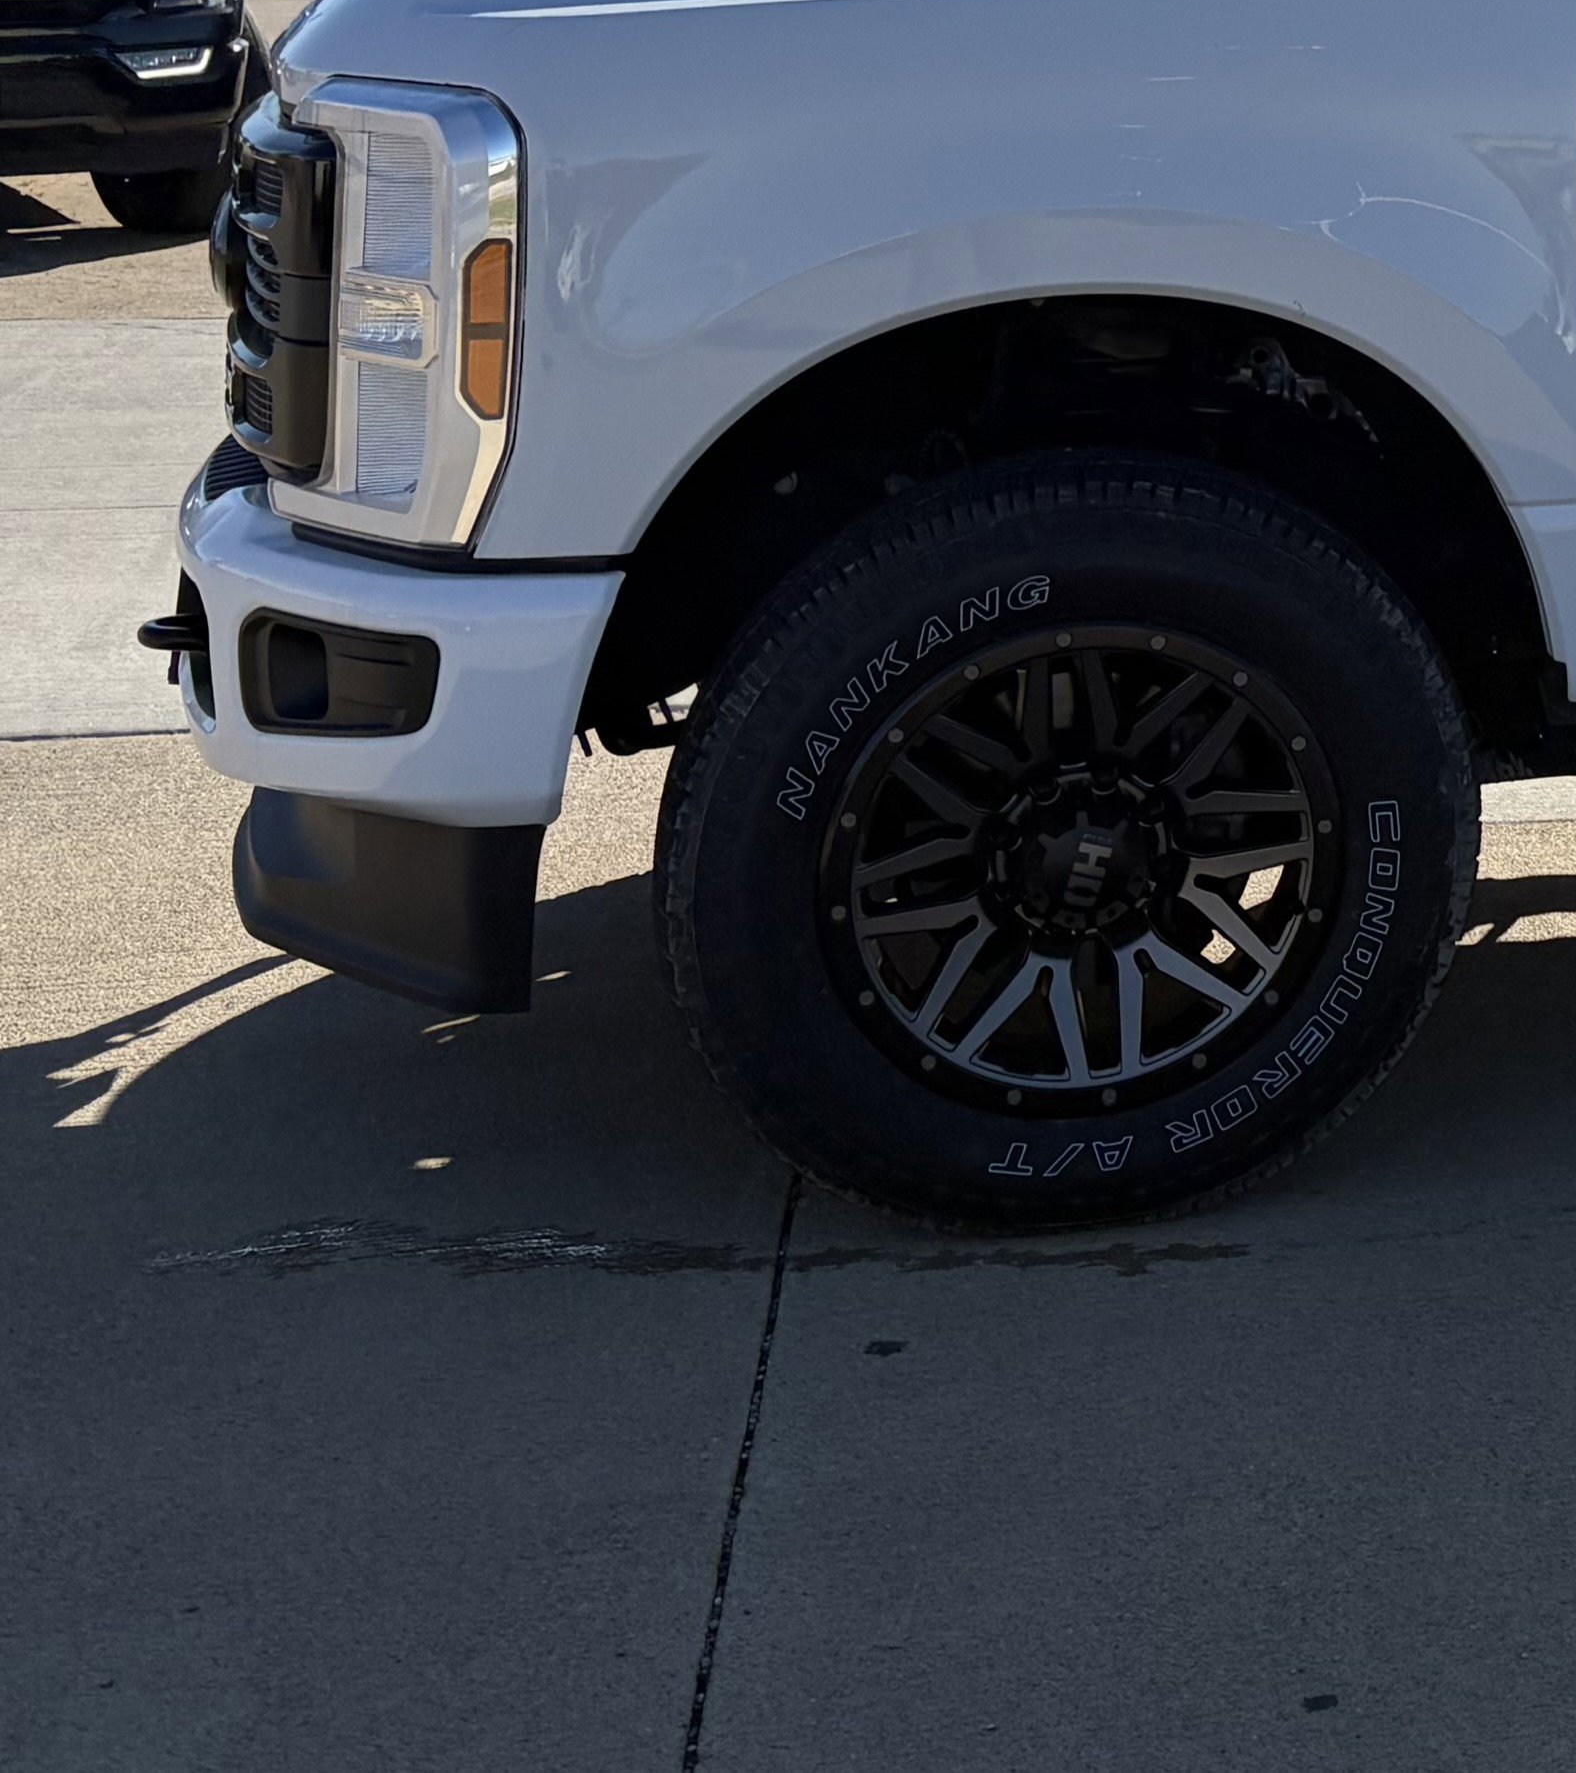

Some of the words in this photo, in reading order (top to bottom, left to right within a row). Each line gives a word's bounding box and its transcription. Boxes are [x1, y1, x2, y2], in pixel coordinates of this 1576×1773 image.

[775, 574, 1051, 820] NANKANG
[1166, 800, 1401, 1154] CONQUEROR
[988, 1135, 1134, 1177] A/T
